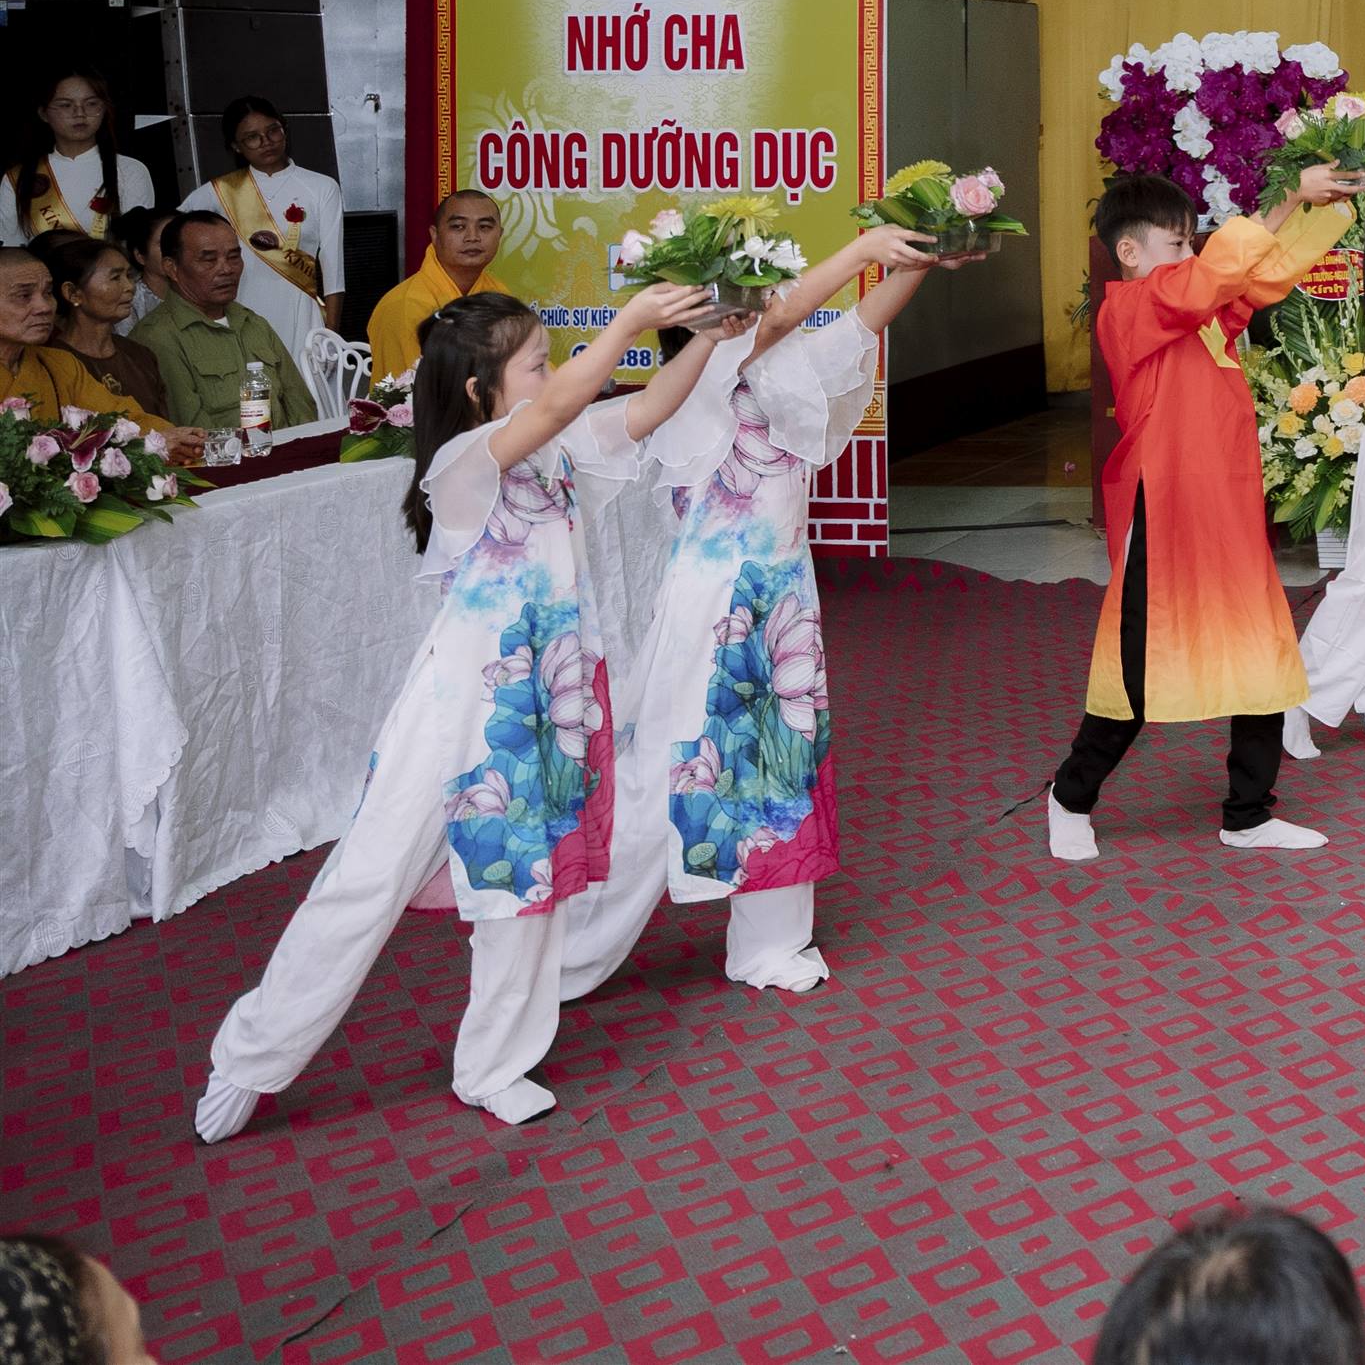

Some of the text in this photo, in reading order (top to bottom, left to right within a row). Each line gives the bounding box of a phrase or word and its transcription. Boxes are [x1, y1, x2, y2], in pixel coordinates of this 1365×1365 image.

[567, 3, 744, 71] NHỚ CHA
[478, 119, 835, 201] CÔNG DƯỠNG DỤC
[1306, 284, 1344, 295] Kính
[540, 306, 569, 326] CHỨC
[573, 307, 590, 330] SỰ
